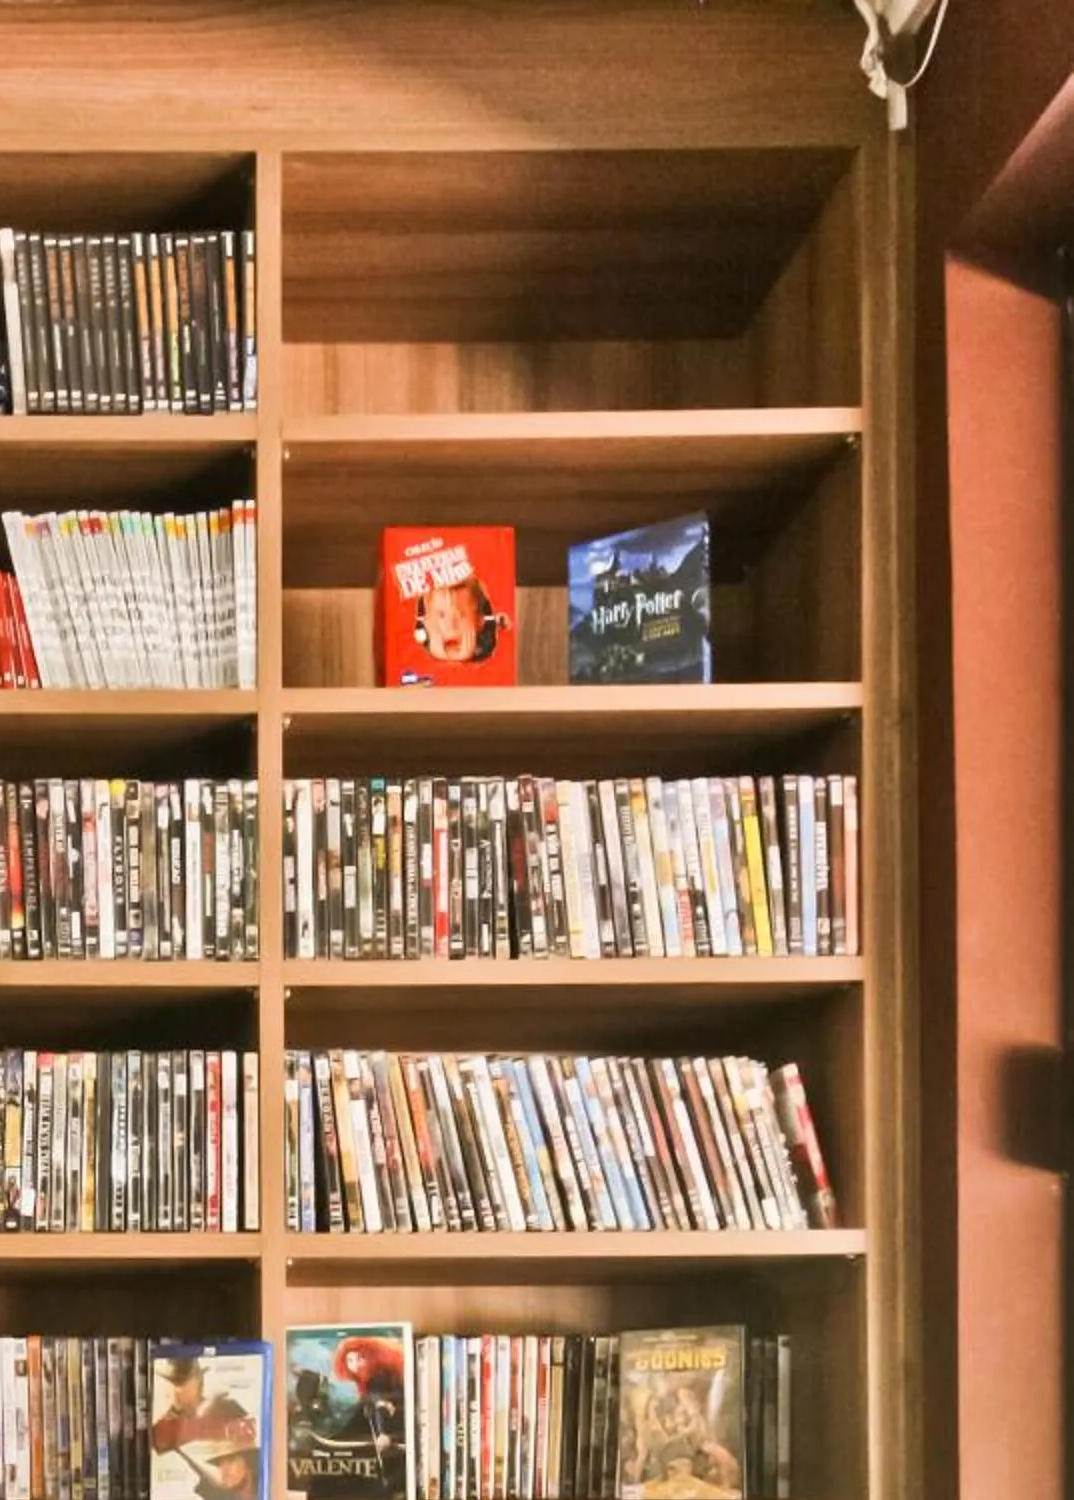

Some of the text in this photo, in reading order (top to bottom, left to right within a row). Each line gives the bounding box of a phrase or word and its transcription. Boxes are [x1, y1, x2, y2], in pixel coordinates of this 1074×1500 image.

[591, 600, 633, 635] Harry
[635, 588, 684, 630] Potter
[289, 1457, 379, 1479] VALENTE
